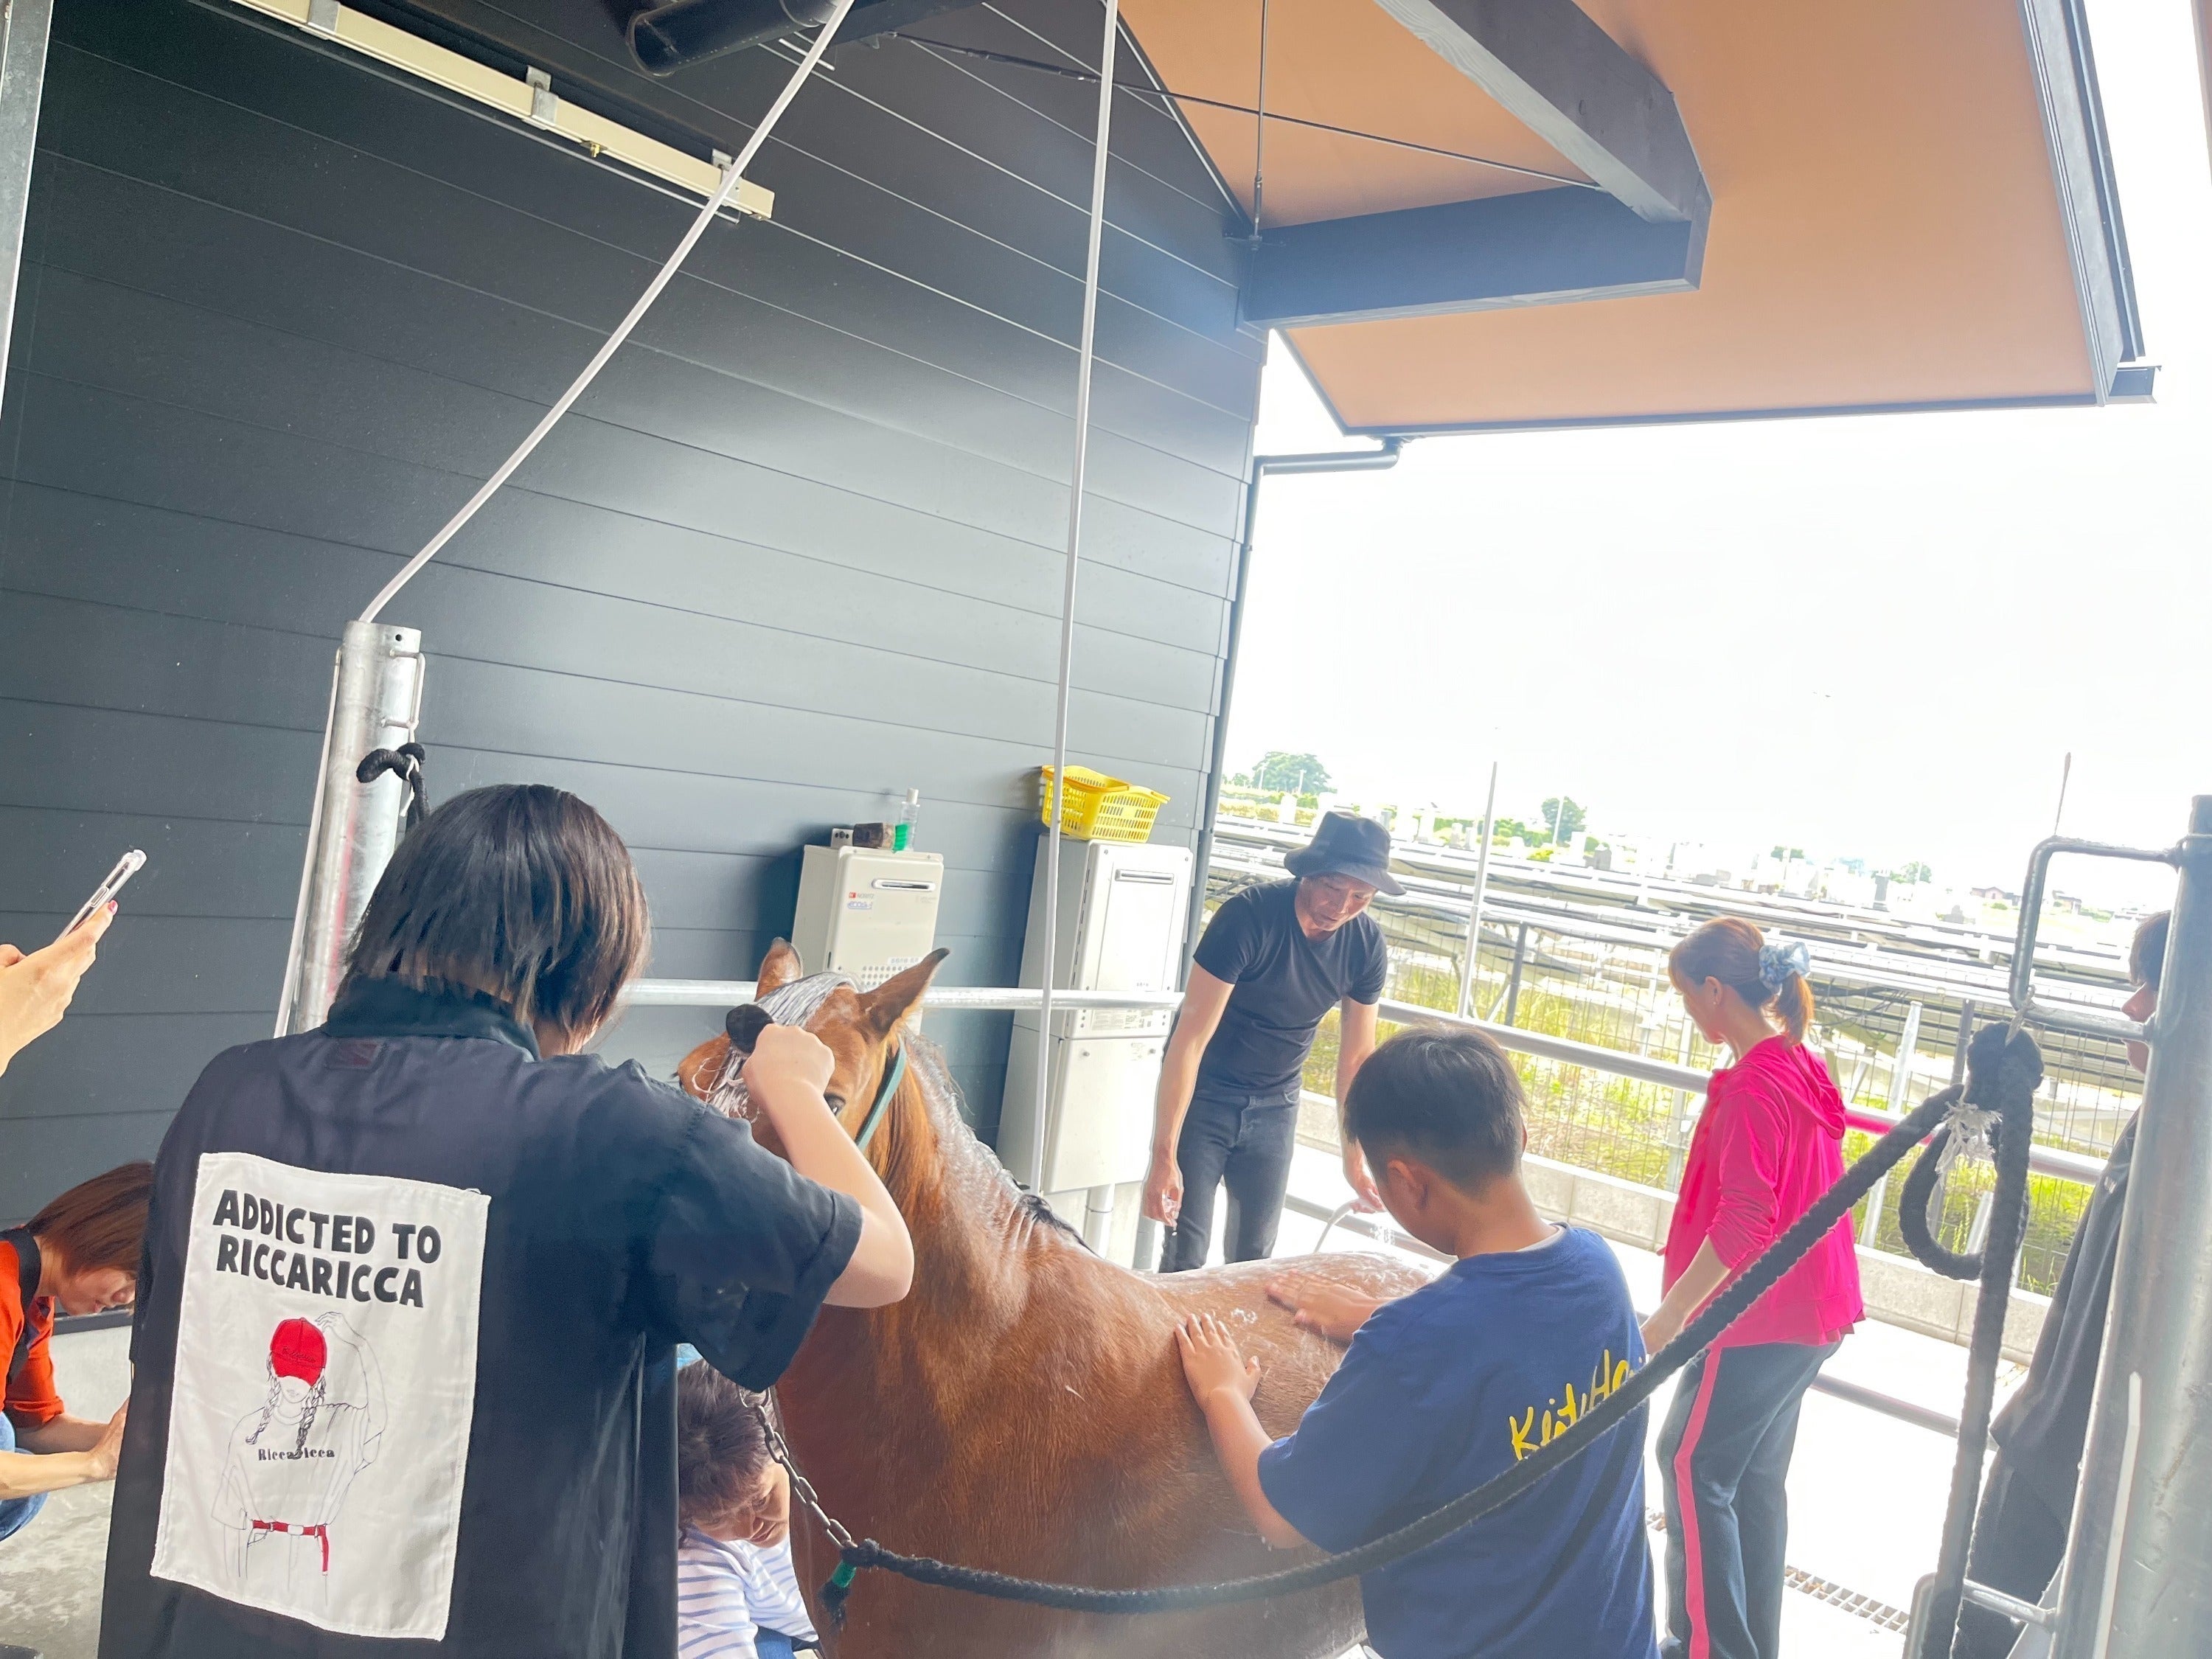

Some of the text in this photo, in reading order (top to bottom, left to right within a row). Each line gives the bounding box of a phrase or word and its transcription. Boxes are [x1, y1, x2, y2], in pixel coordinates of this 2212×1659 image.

[212, 1189, 442, 1264] ADDICTED TO
[216, 1234, 424, 1308] RICCARICCA
[258, 1447, 335, 1461] Riccaicca
